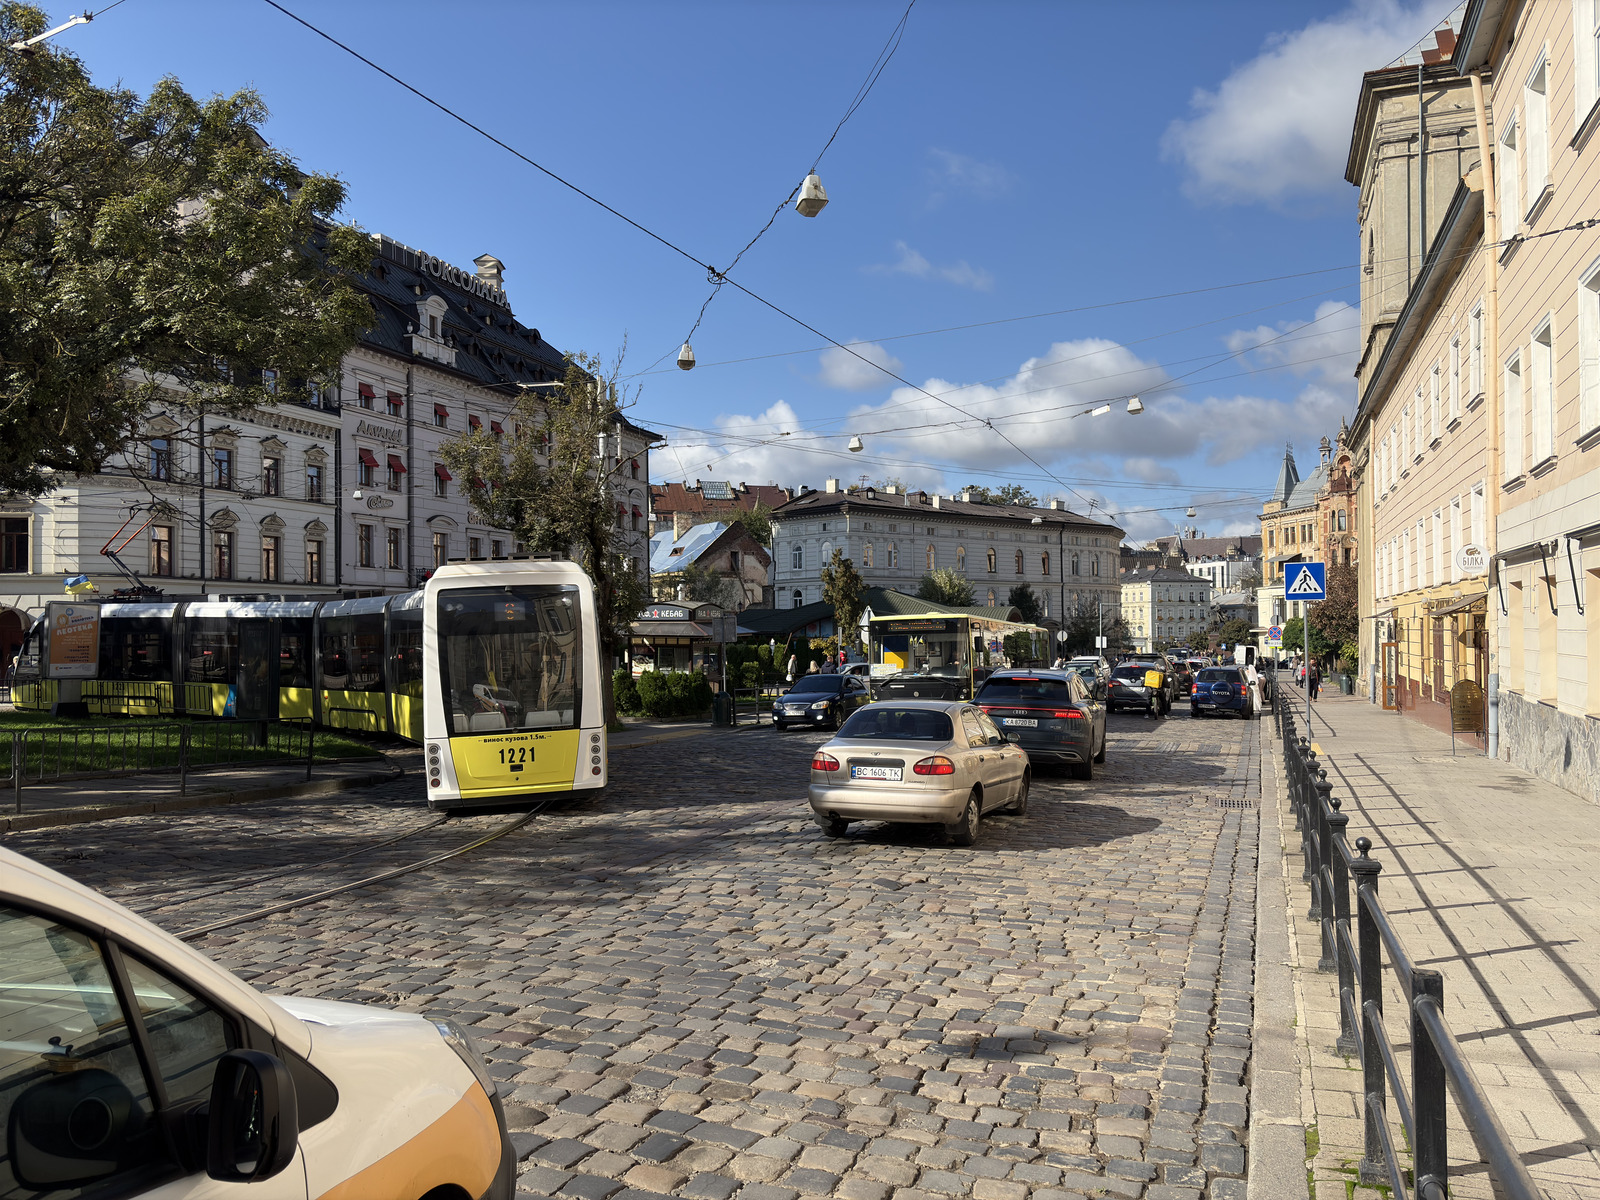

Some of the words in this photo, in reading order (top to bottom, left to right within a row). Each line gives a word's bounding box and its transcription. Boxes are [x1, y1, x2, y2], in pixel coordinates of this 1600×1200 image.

[420, 250, 511, 309] РОКСОЛАНА
[1463, 557, 1484, 566] БІЛКА
[661, 610, 684, 618] КЕБАБ
[505, 735, 529, 743] кузова
[498, 746, 535, 764] 1221
[856, 767, 868, 776] BC
[869, 768, 887, 777] 1606
[888, 769, 900, 778] TK
